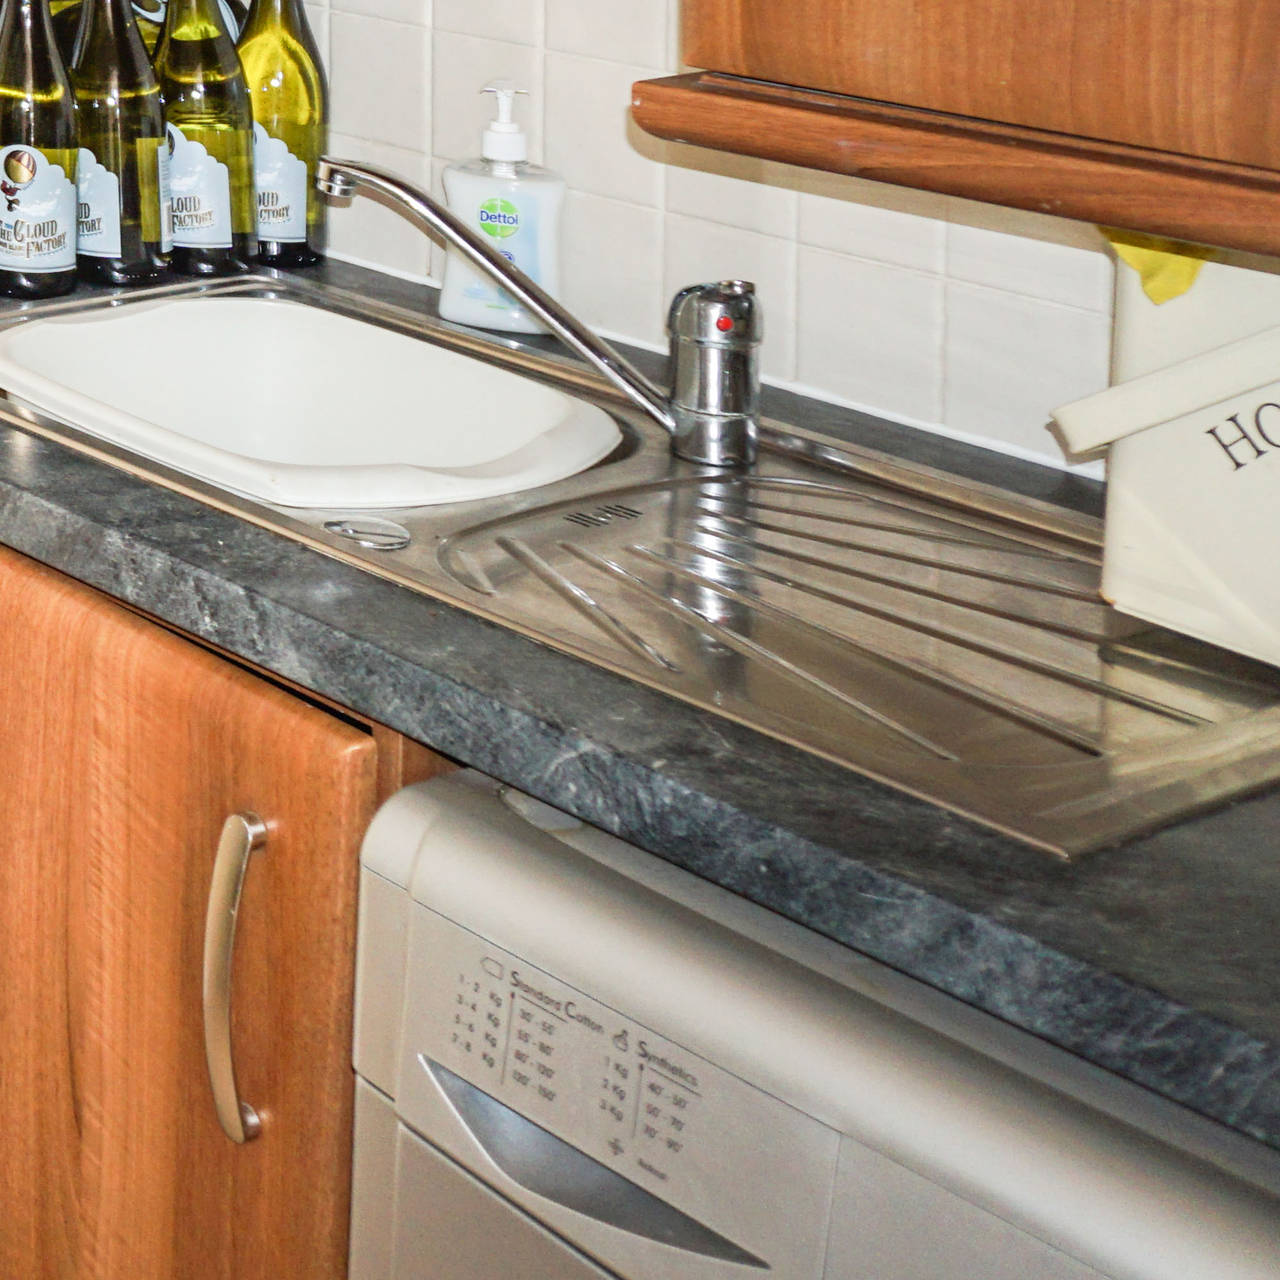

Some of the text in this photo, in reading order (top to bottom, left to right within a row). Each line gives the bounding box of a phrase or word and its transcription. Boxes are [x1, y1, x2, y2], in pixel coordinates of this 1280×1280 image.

[171, 209, 214, 234] FACTORY
[480, 209, 519, 226] Dettol
[13, 219, 58, 242] CLOUD
[26, 232, 67, 258] FACTORY
